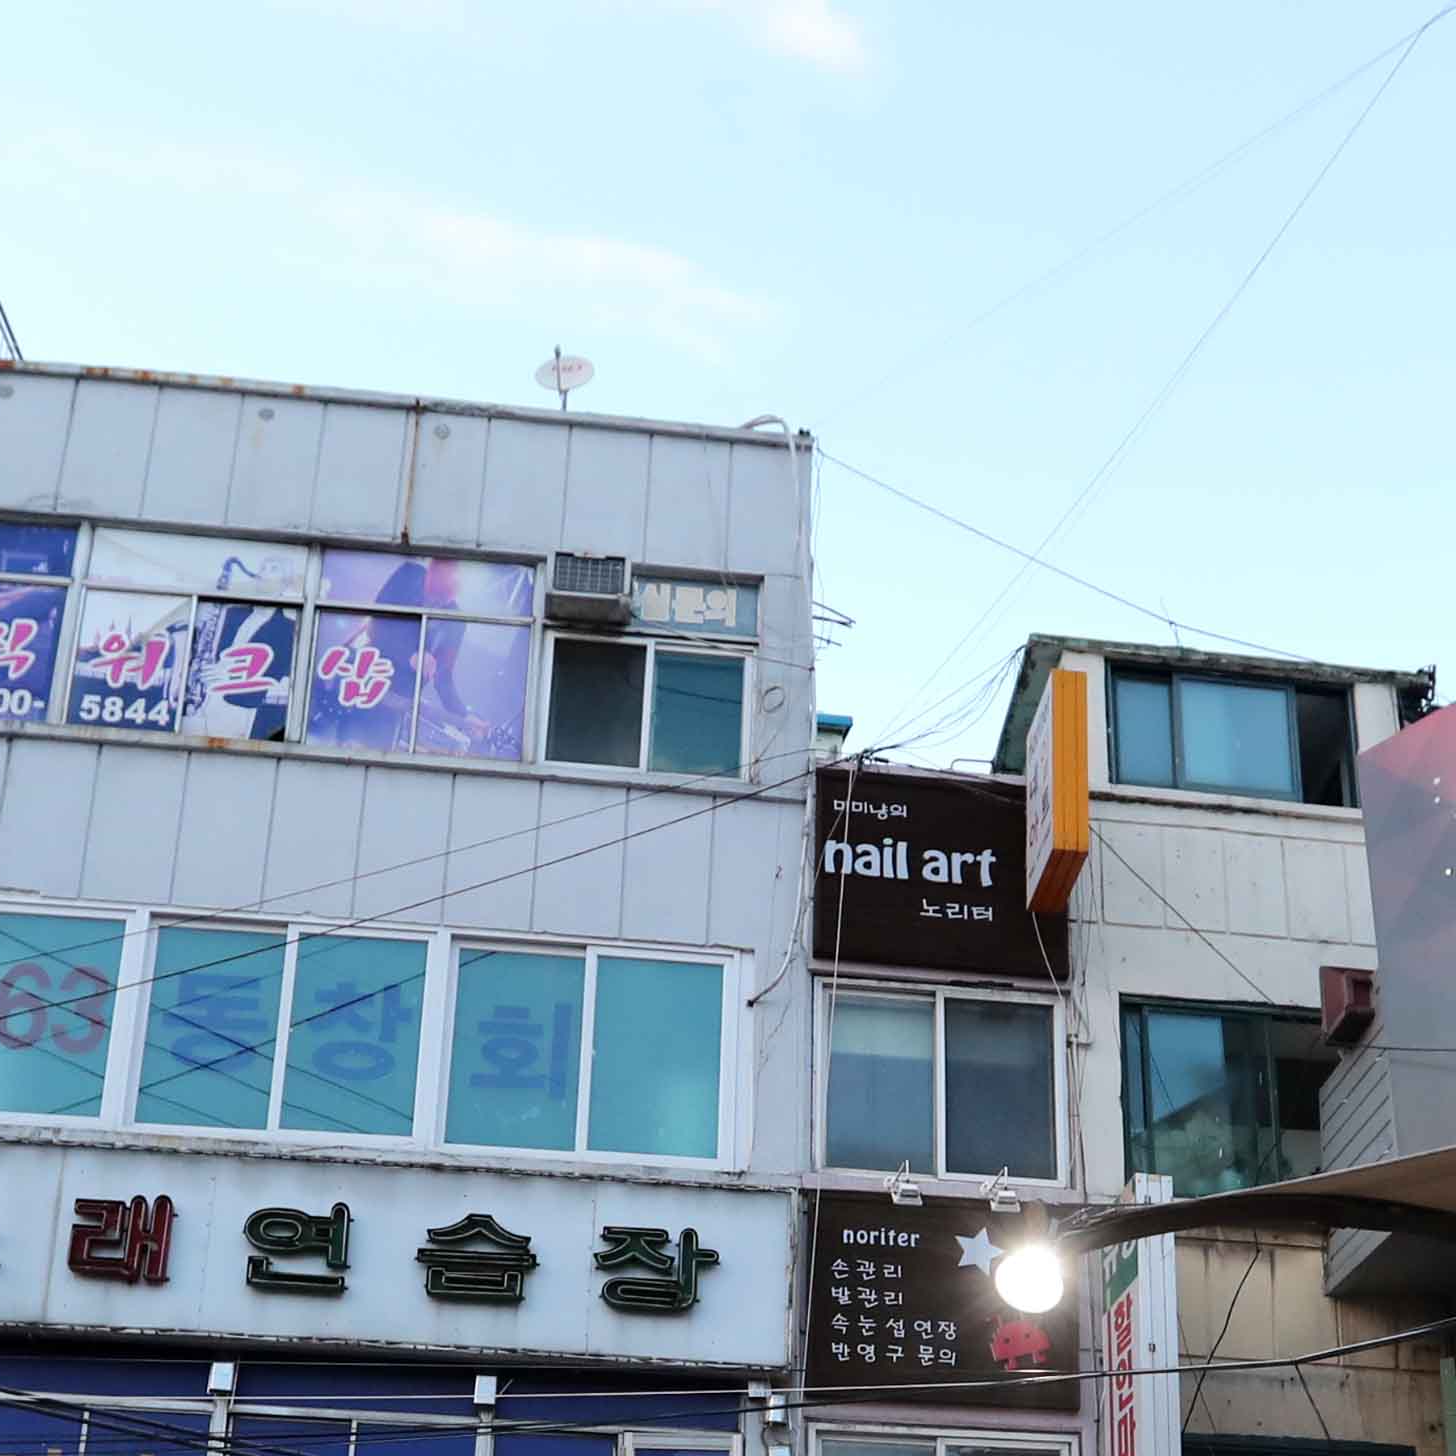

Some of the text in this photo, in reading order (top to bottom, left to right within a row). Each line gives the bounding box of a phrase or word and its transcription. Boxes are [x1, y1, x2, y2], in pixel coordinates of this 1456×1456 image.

[823, 838, 997, 887] nail art
[920, 899, 993, 921] 노리터
[842, 1228, 920, 1248] noriter
